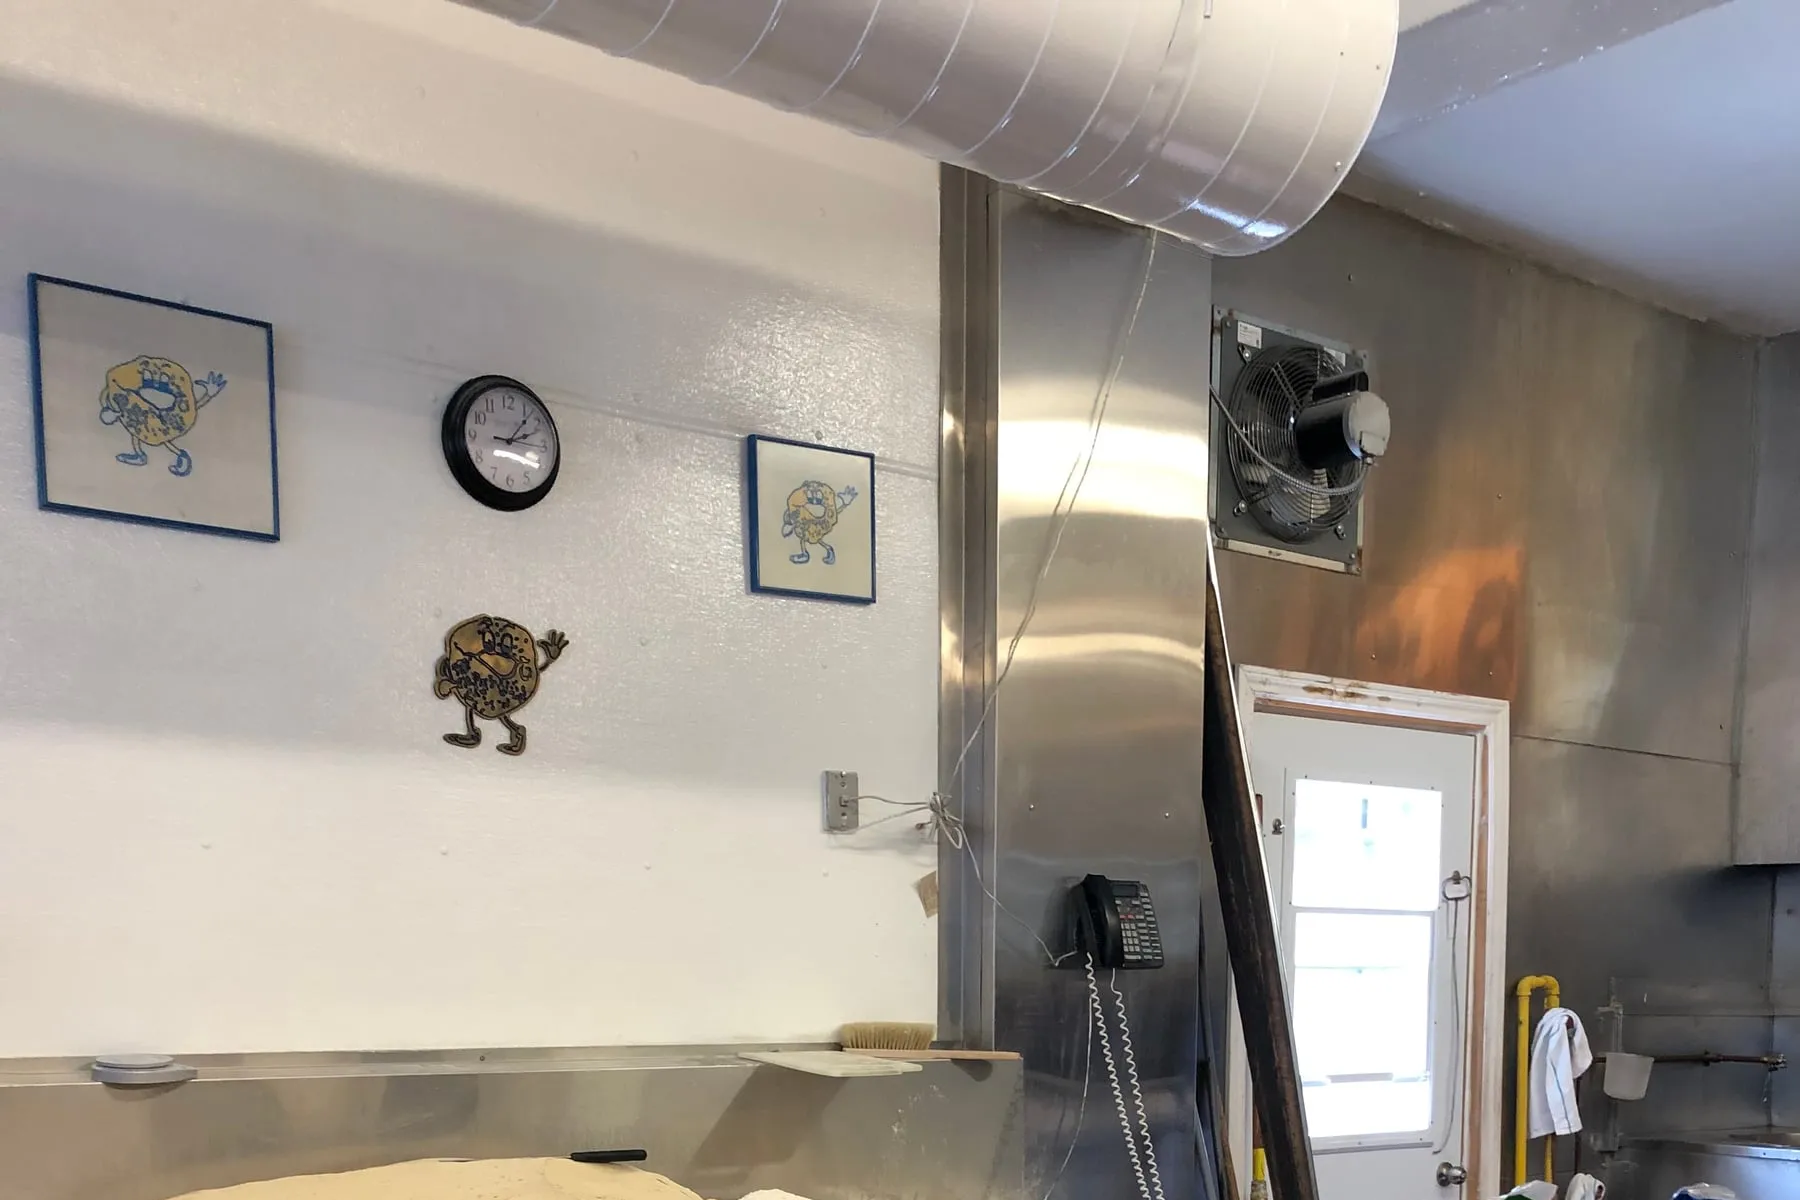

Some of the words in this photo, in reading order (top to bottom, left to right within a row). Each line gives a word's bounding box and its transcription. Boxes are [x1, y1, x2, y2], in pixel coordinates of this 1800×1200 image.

[484, 398, 495, 413] 11
[501, 395, 515, 411] 12
[474, 411, 486, 425] 10
[468, 429, 477, 442] 9
[540, 439, 548, 454] 3
[475, 450, 484, 463] 8
[490, 467, 498, 480] 7
[506, 473, 514, 487] 6
[523, 471, 530, 485] 5
